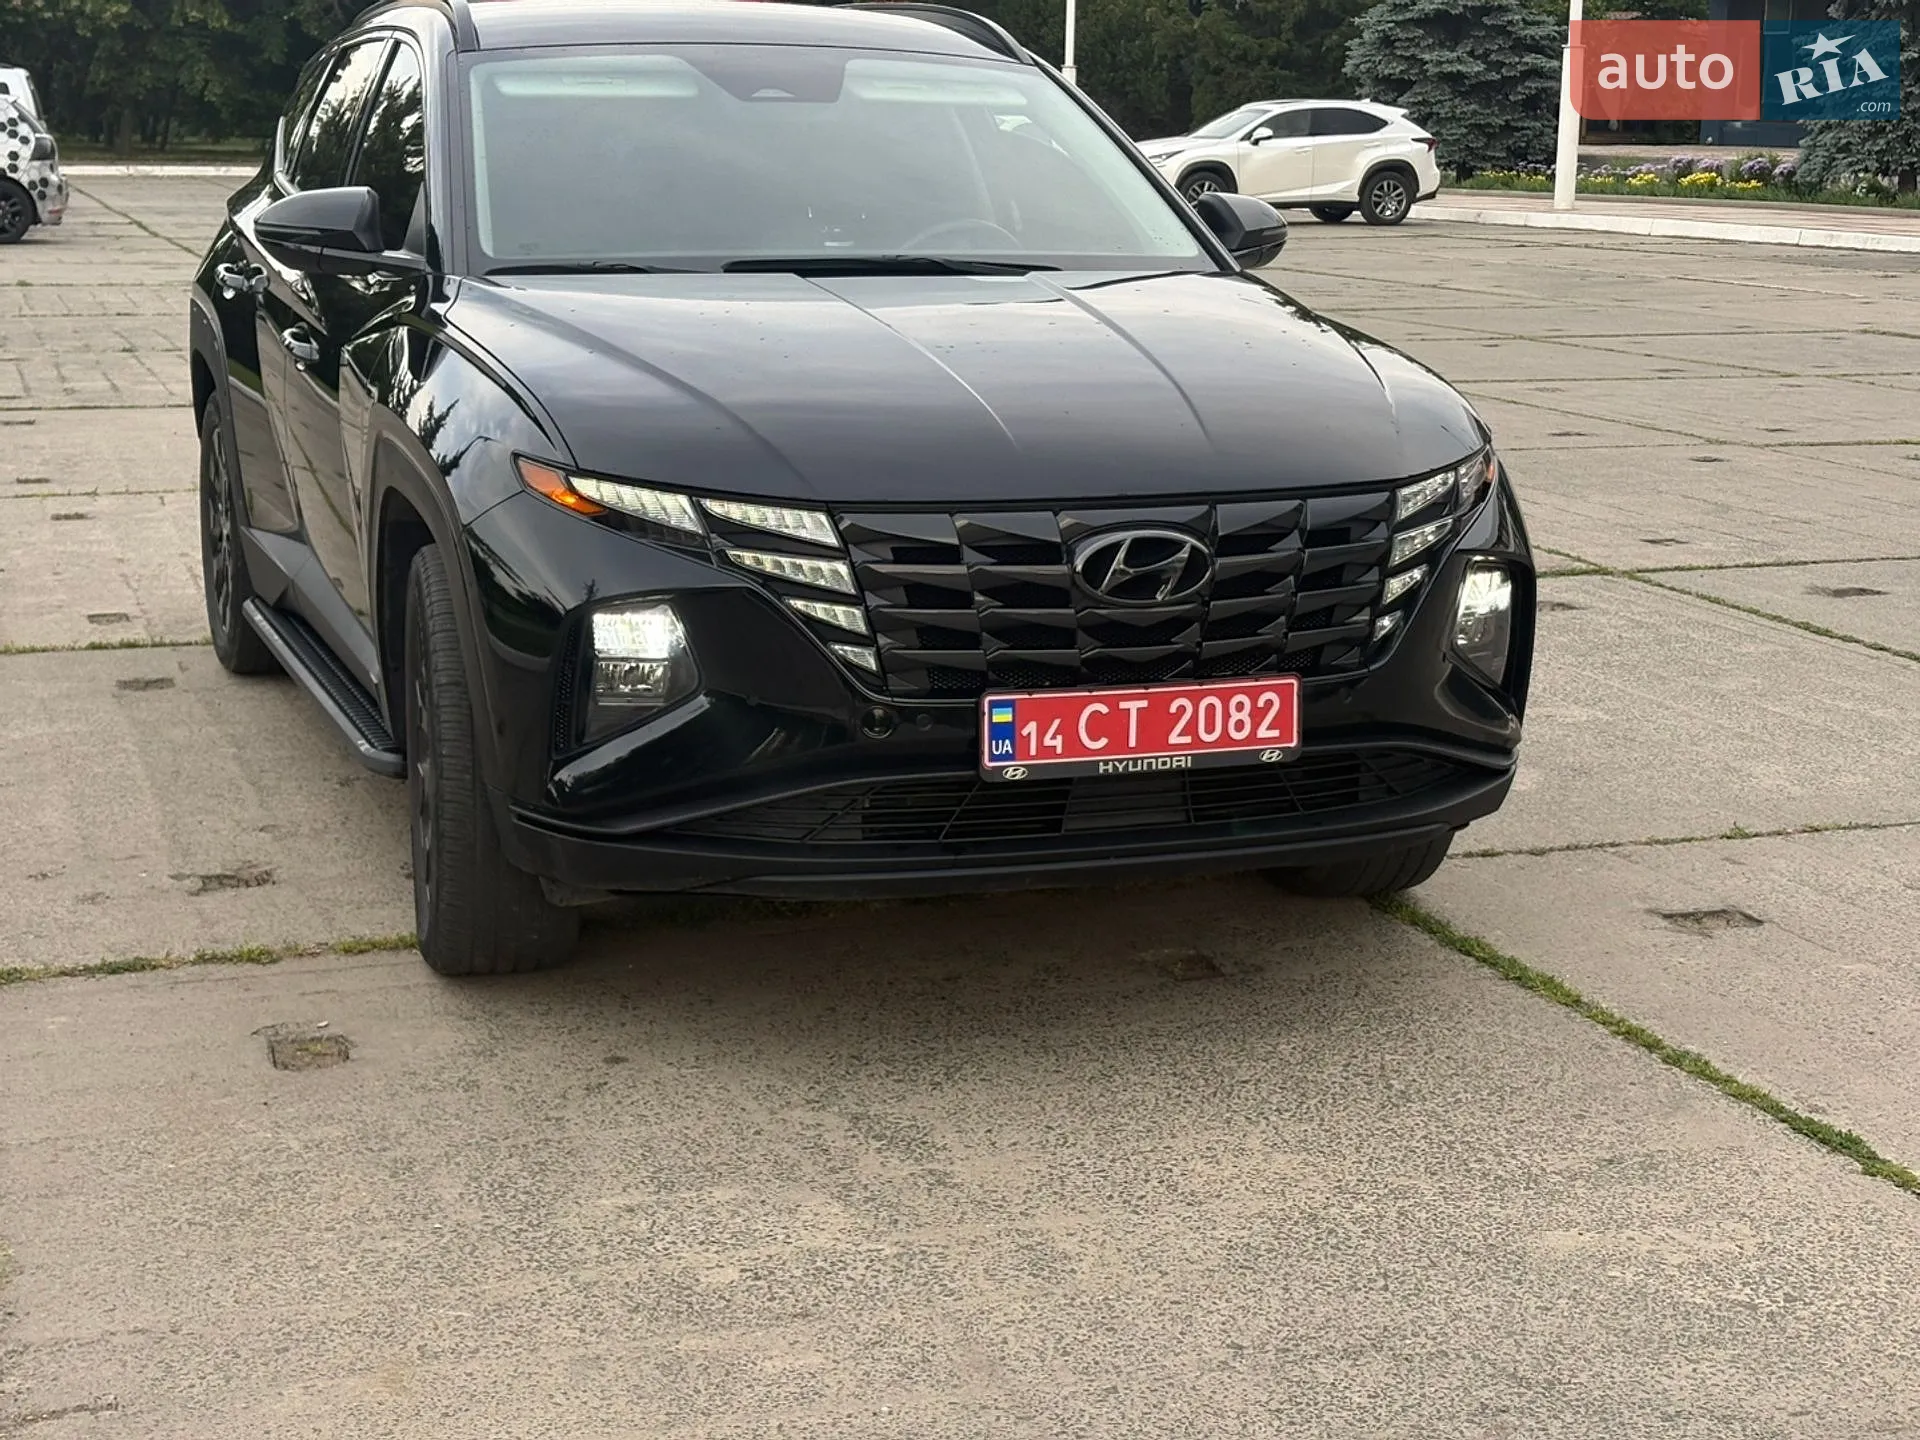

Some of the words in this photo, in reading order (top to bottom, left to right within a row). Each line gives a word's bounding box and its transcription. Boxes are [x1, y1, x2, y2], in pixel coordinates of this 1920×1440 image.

[1020, 718, 1063, 756] 14
[1077, 699, 1149, 750] CT
[1168, 691, 1281, 745] 2082
[992, 740, 1013, 755] UA
[1099, 756, 1192, 774] HYUNDAI
